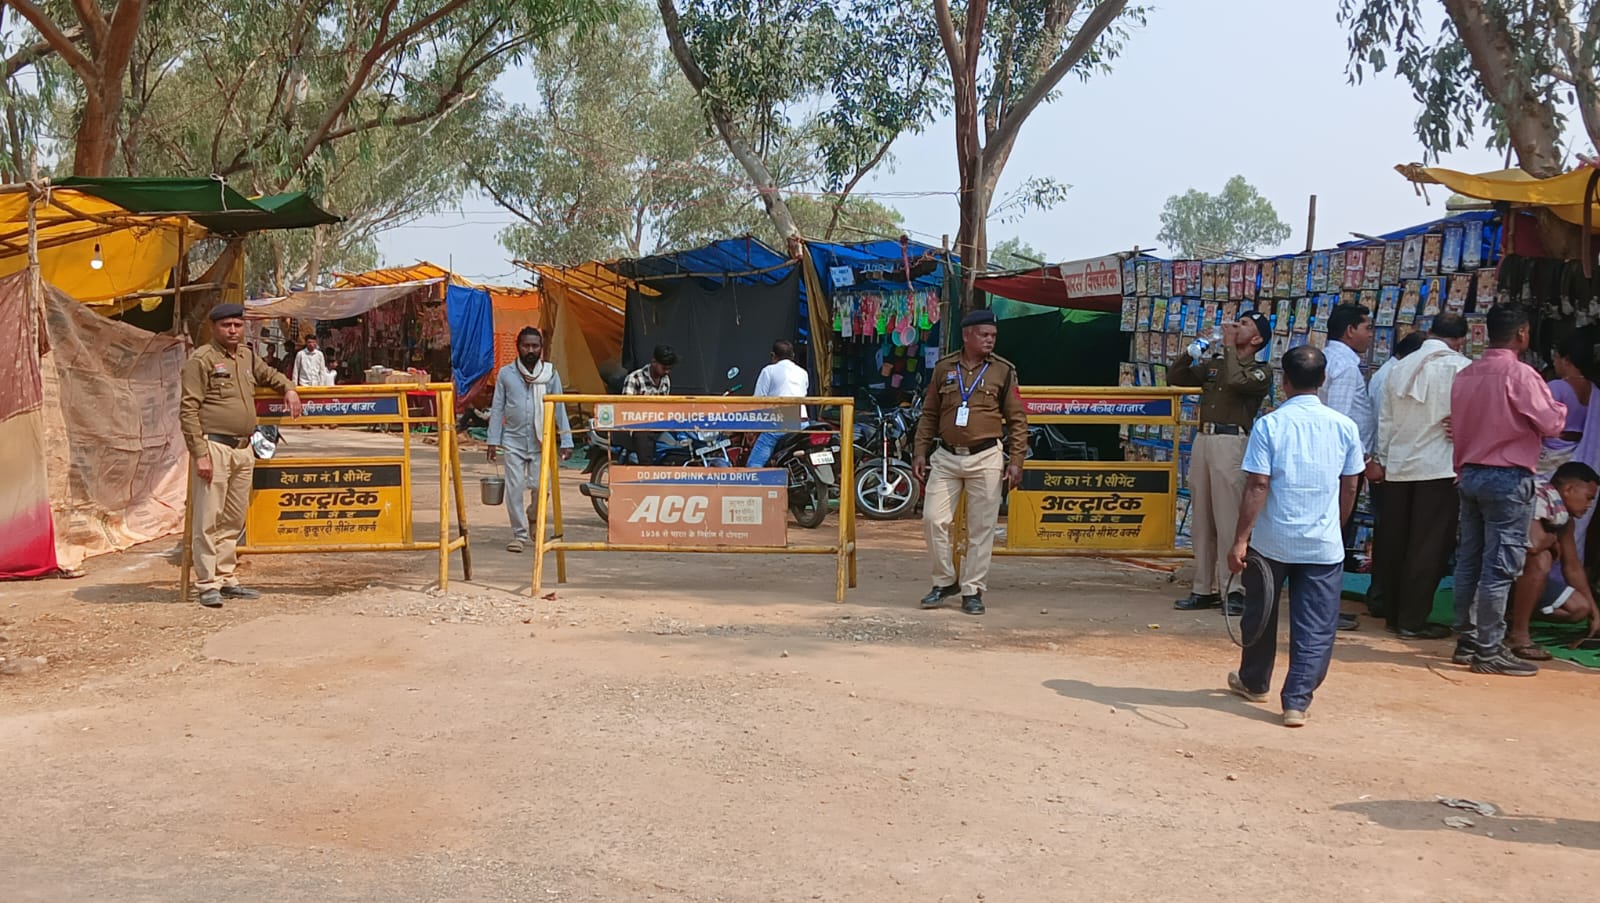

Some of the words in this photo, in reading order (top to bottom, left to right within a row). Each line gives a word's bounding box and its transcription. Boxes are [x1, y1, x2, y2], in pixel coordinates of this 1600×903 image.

[1027, 402, 1063, 413] यातायात
[1064, 400, 1090, 414] पुलिस
[621, 411, 664, 422] TRAFFIC
[667, 411, 705, 422] POLICE
[707, 411, 785, 423] BALODABAZAR
[280, 471, 299, 485] देश
[302, 472, 318, 483] का
[637, 471, 651, 480] DO
[652, 471, 672, 480] NOT
[674, 472, 704, 481] DRINK
[706, 472, 727, 481] AND
[1044, 473, 1062, 487] देश
[1064, 475, 1080, 486] का
[627, 495, 709, 524] ACC
